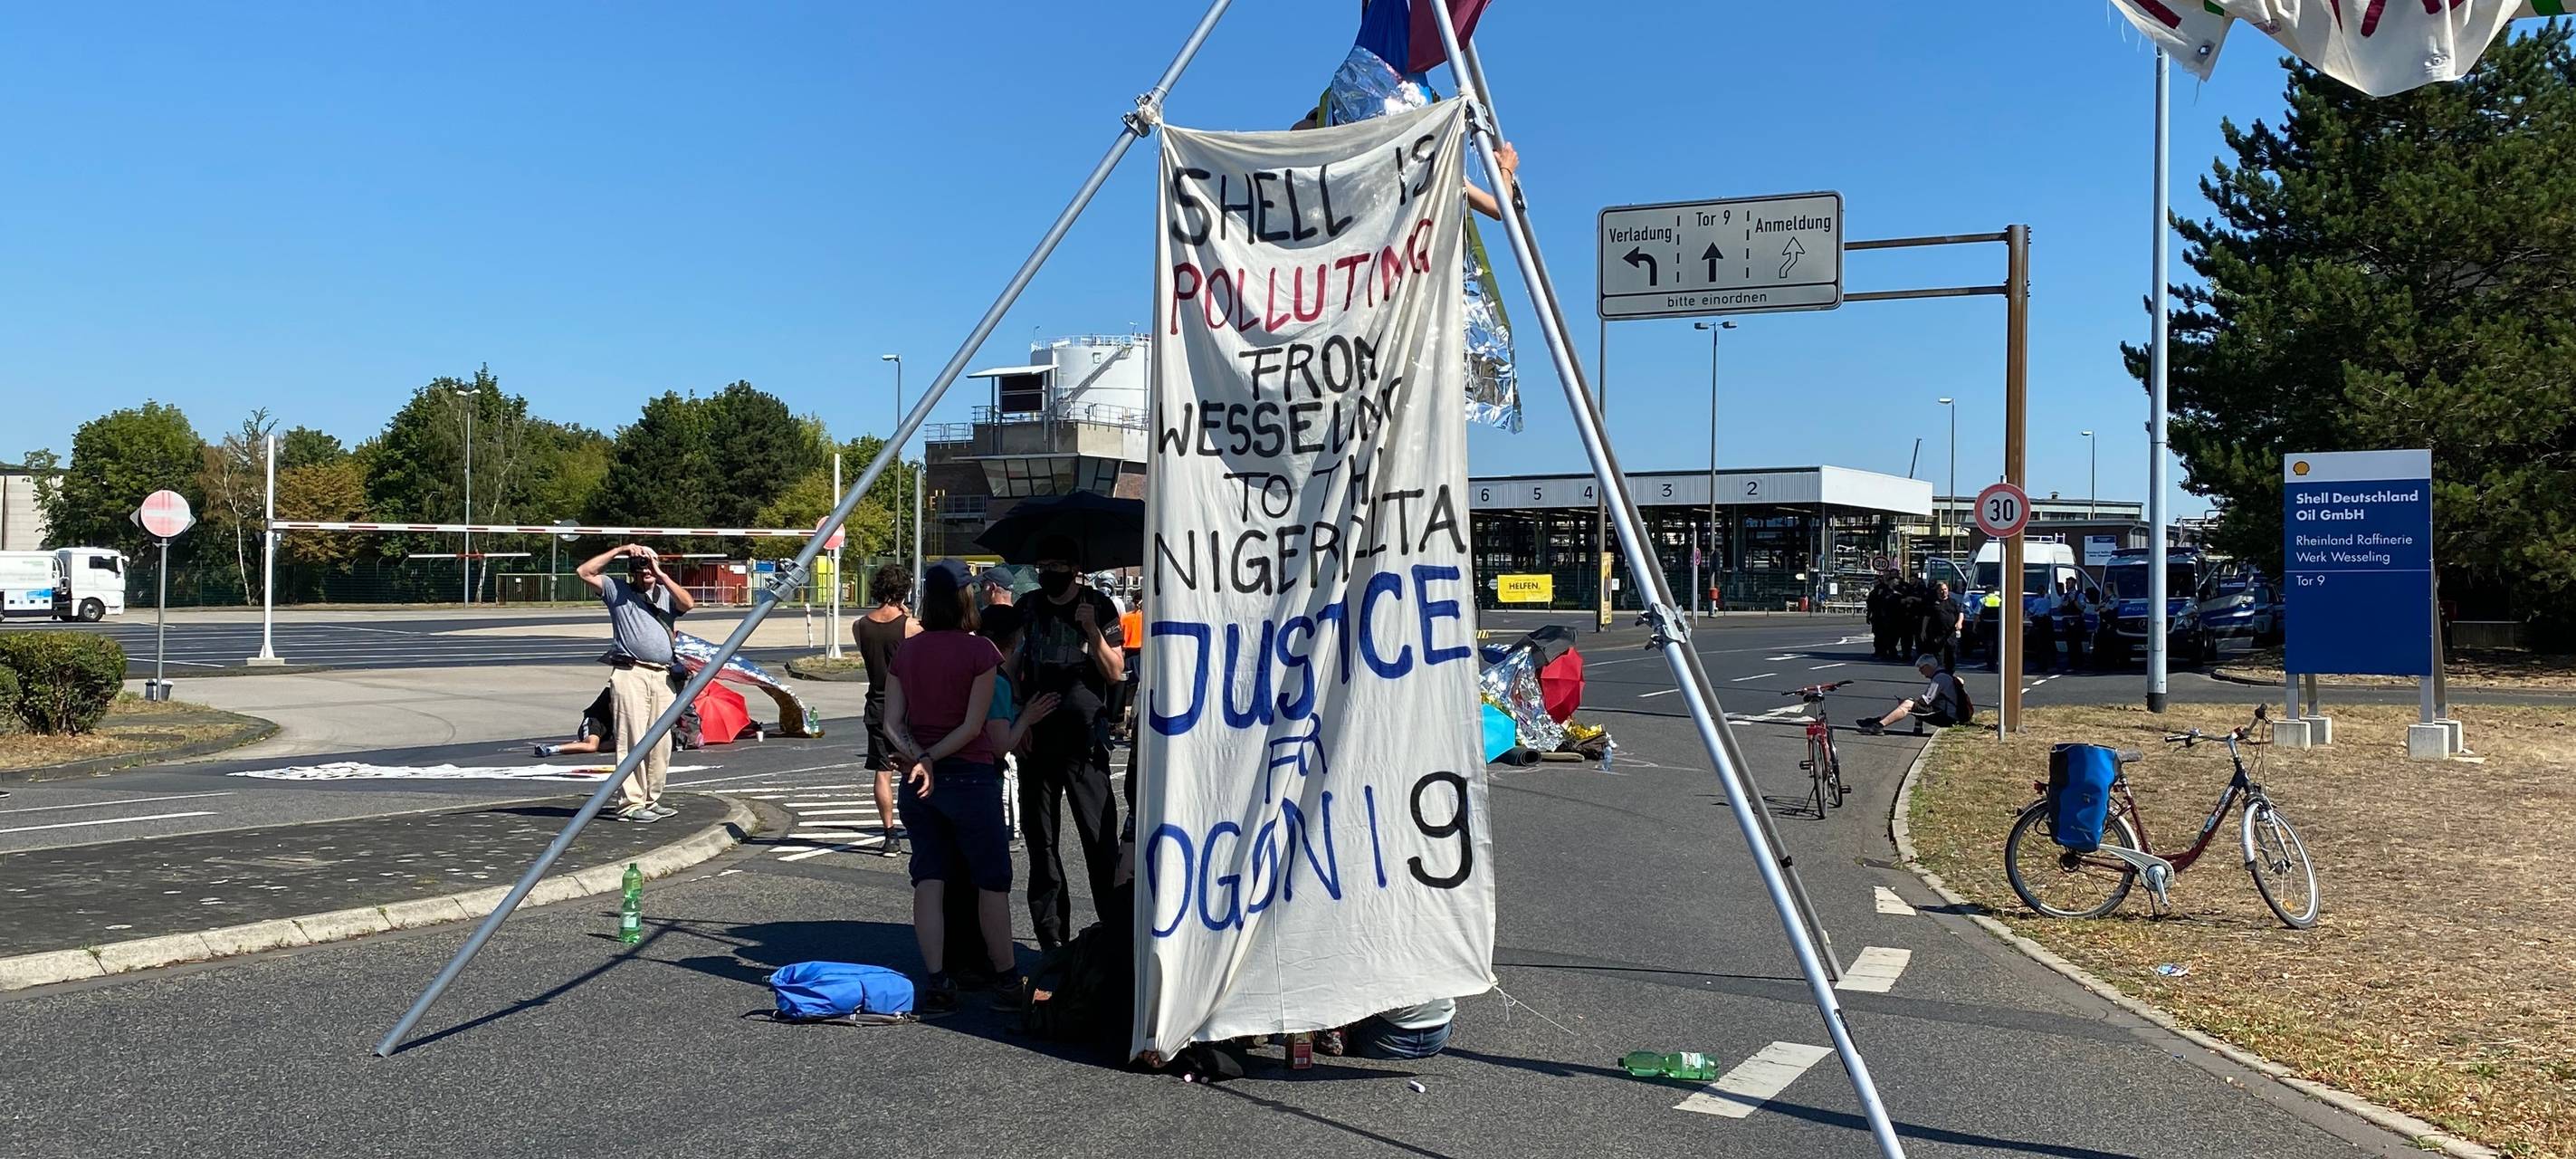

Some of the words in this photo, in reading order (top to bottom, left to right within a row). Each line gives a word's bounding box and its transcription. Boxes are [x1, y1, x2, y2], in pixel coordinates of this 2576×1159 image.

[1171, 164, 1353, 246] SHELL
[1396, 134, 1435, 206] IS
[1696, 212, 1716, 226] Tor
[1723, 210, 1731, 225] 9
[1755, 215, 1832, 234] Anmeldung
[1609, 225, 1672, 244] Verladung
[1170, 218, 1433, 335] POLLUTING
[1667, 296, 1695, 308] bitte
[1702, 292, 1767, 306] einordnen
[1239, 331, 1382, 402] FROM
[1224, 471, 1293, 522] TO
[1312, 448, 1383, 513] TH
[1584, 485, 1593, 499] 4
[1662, 484, 1673, 497] 3
[1747, 482, 1758, 495] 2
[1481, 488, 1490, 502] 6
[1533, 487, 1541, 500] 5
[2296, 492, 2329, 504] Shell
[2333, 490, 2419, 503] Deutschland
[1989, 499, 2014, 522] 30
[2296, 509, 2316, 521] Oil
[2320, 509, 2365, 521] GmbH
[2296, 534, 2353, 546] Rheinland
[2357, 533, 2413, 545] Raffinerie
[2296, 551, 2327, 562] Werk
[2331, 551, 2390, 564] Wesseling
[2296, 575, 2314, 586] Tor
[2317, 575, 2325, 586] 9
[1407, 771, 1474, 889] 9
